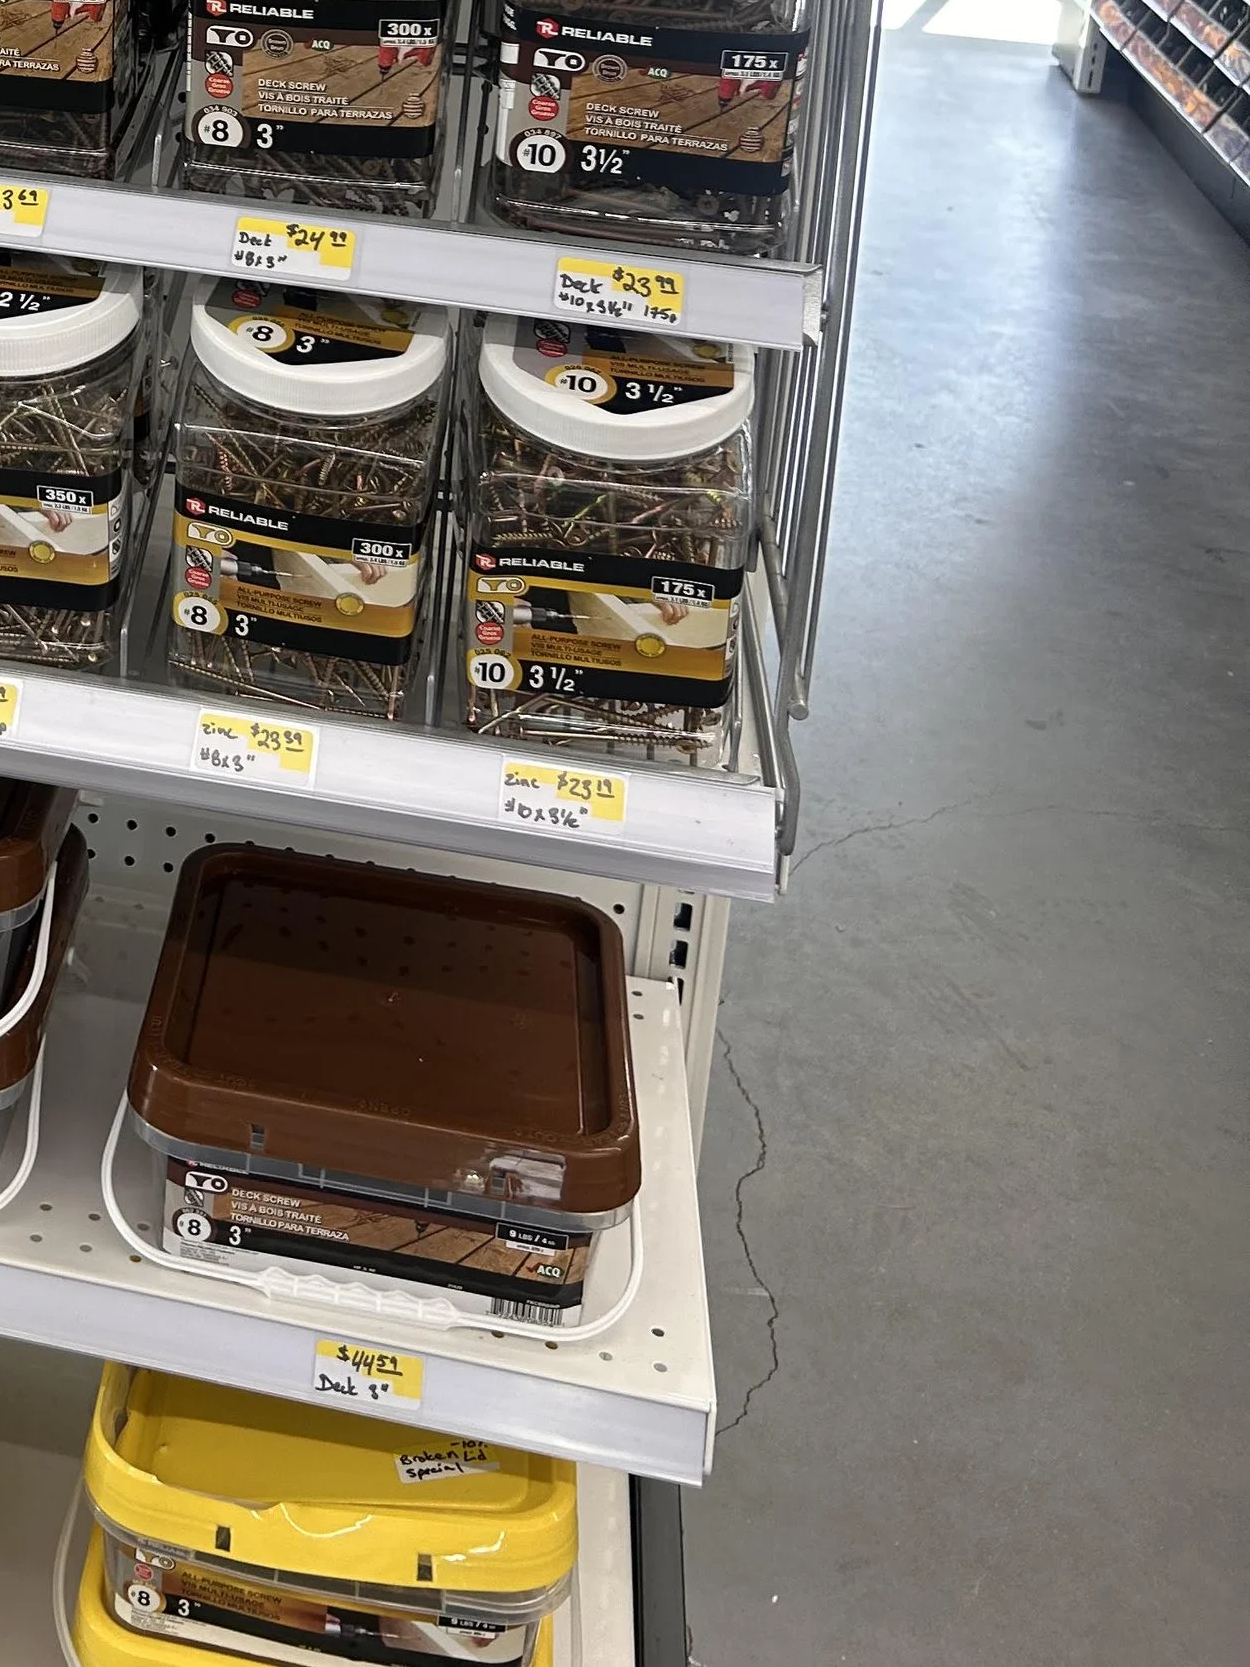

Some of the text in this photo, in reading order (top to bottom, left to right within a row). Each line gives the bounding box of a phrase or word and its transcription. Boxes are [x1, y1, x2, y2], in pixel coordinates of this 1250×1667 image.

[229, 3, 315, 20] RELIABLE
[311, 38, 332, 50] ACQ
[561, 25, 654, 48] RELIABLE
[11, 58, 61, 73] TERRAZAS
[647, 65, 669, 79] ACQ
[258, 77, 327, 93] DECK SCREW
[258, 91, 350, 106] VIS BOIS TRAITÉ
[258, 102, 393, 121] TORNILLO PARA TERRAZAS
[585, 101, 660, 120] DECK SCREW
[616, 116, 683, 135] BOIS TRAITÉ
[583, 126, 729, 153] TORNILLO PARA TERRAZAS
[560, 273, 604, 295] Deck
[208, 505, 290, 532] RELIABLE
[498, 556, 586, 573] RELIABLE
[231, 1187, 302, 1209] DECK SCREW
[230, 1199, 323, 1225] VIS BOIS TRAITÉ
[230, 1212, 351, 1242] TORNILLO PARA TERRAZA
[536, 1265, 561, 1279] ACQ
[315, 1373, 359, 1396] Deck
